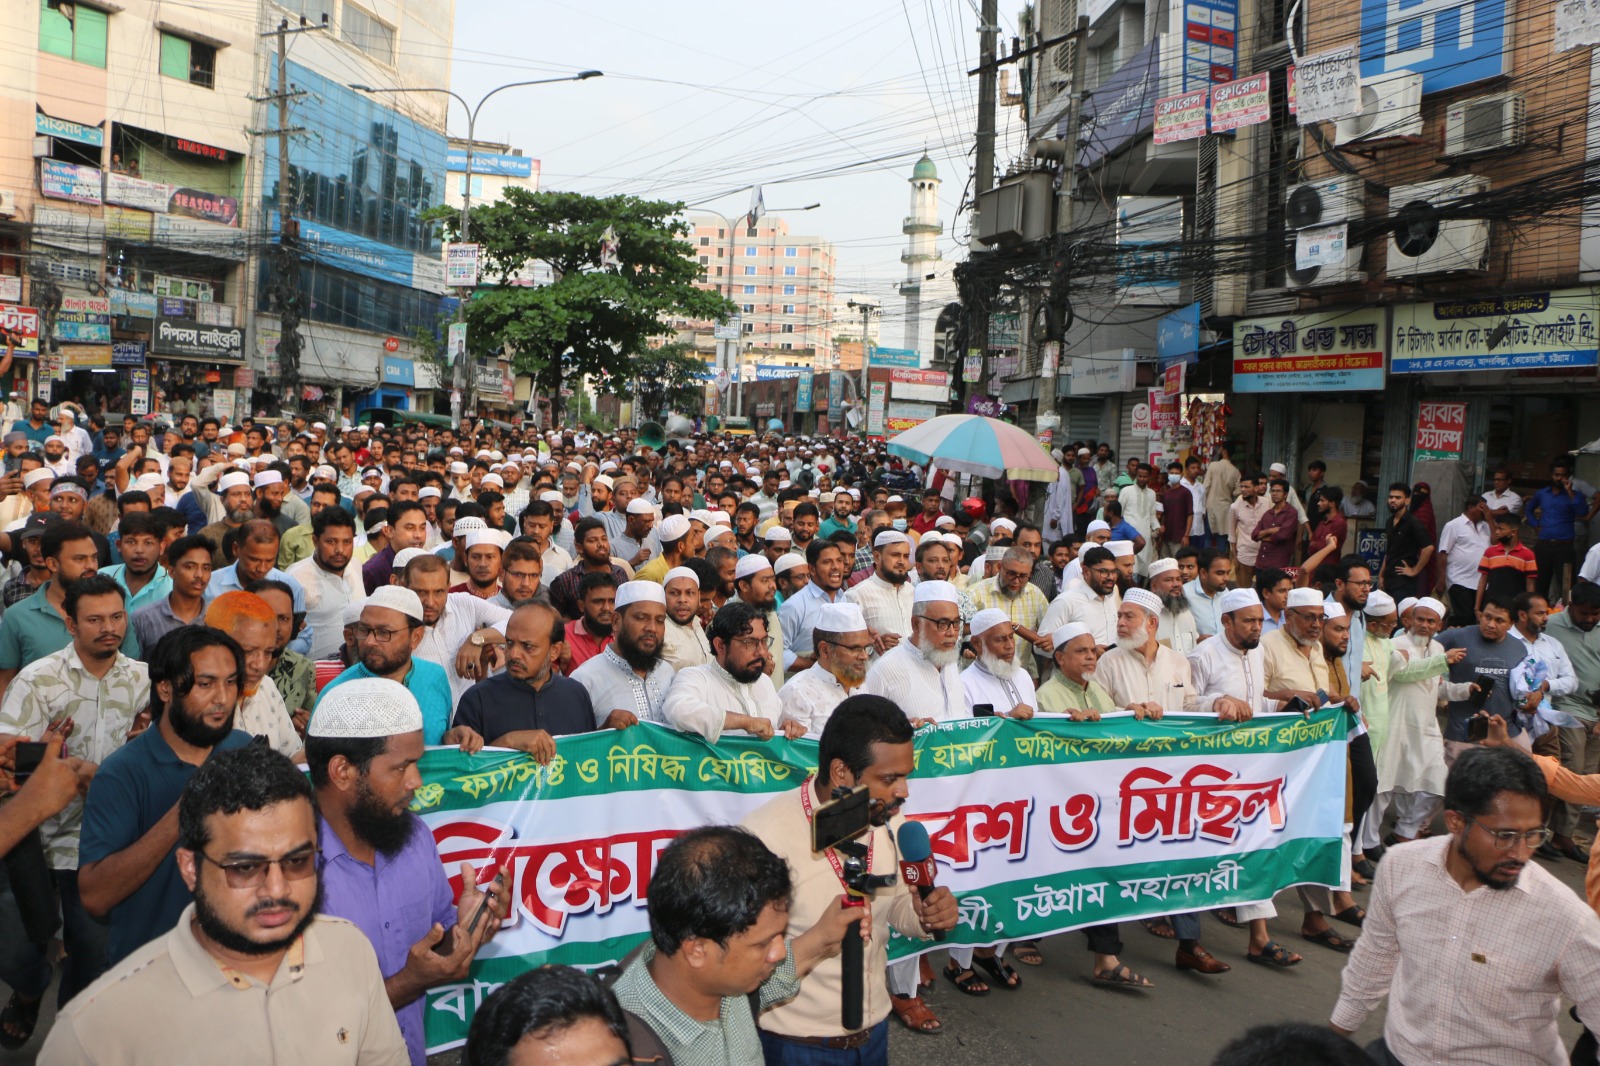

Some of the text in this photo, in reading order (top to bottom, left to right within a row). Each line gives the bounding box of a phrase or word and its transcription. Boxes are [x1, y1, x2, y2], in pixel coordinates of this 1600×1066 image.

[1214, 78, 1262, 101] ফ্লোরেন্স
[1158, 94, 1201, 115] ফ্লোরেন্স
[177, 139, 227, 161] SEASON'Z
[174, 193, 231, 216] SEASON'Z
[200, 329, 242, 348] লাইব্রেরী
[1243, 320, 1378, 358] চৌধুরী এন্ড সন্স
[1396, 326, 1406, 353] দি
[1407, 324, 1435, 353] চিটাগাং
[1438, 322, 1463, 351] আর্বান
[1533, 313, 1577, 346] সোসাইটি
[386, 365, 400, 376] CRM
[1419, 403, 1465, 424] রাবার
[1132, 421, 1150, 431] নগদ
[1418, 423, 1462, 451] স্ট্যাম্প
[1360, 532, 1388, 557] চৌধুরী
[1475, 667, 1508, 675] RESPECT
[1014, 730, 1133, 761] অগ্নিসংযোগ
[1136, 736, 1176, 753] এবং
[1276, 718, 1335, 746] প্রতিবাদে
[576, 759, 599, 783] ও
[607, 744, 691, 783] নিষিদ্ধ
[698, 751, 798, 785] ঘোষিত
[1050, 794, 1095, 845] ও
[1119, 764, 1283, 840] মিছিল
[1013, 884, 1110, 920] চট্টগ্রাম
[1117, 860, 1245, 902] মহানগরী
